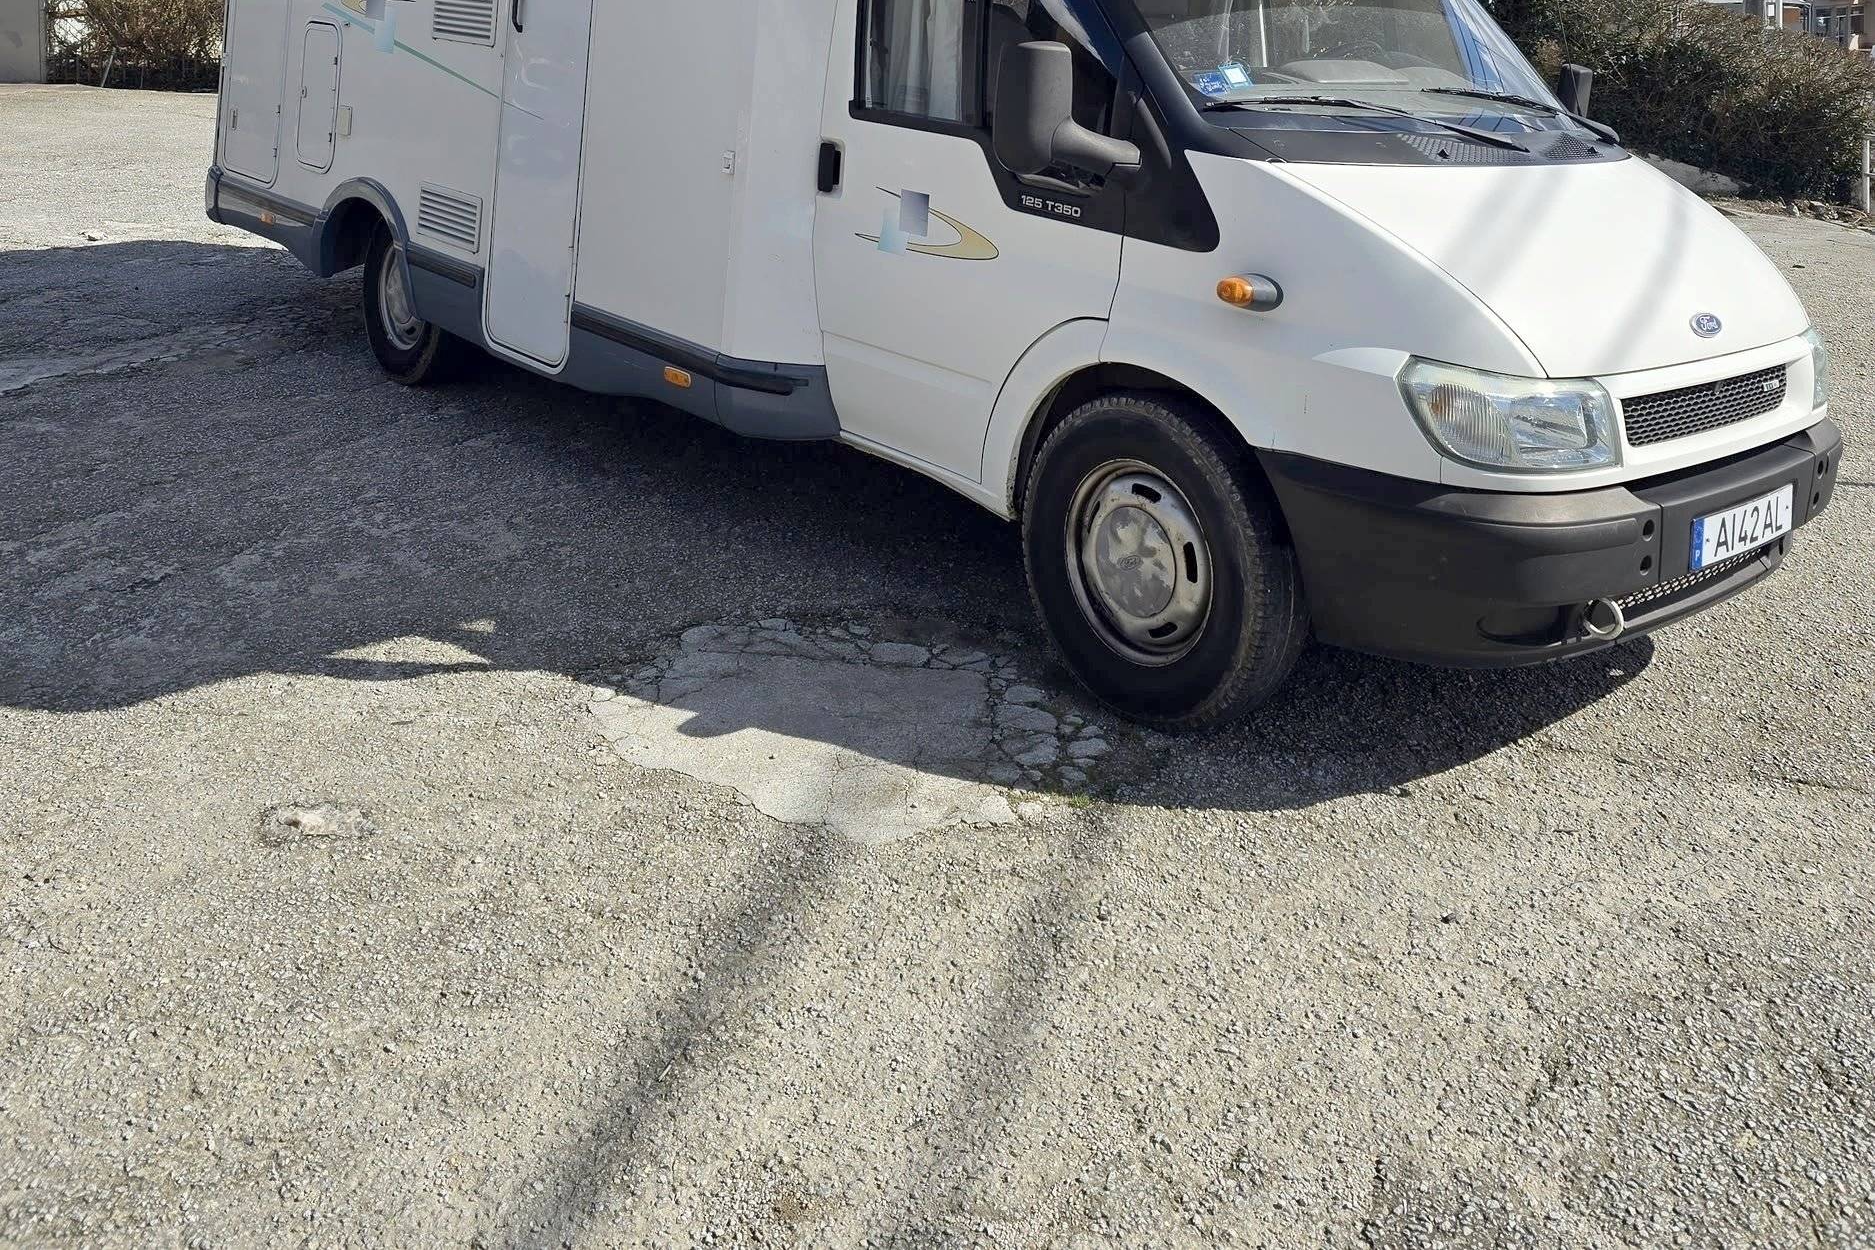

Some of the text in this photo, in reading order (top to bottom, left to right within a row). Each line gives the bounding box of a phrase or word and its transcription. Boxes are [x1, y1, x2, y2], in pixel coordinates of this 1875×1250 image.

[1021, 195, 1081, 218] 125 T350
[1694, 550, 1701, 561] P
